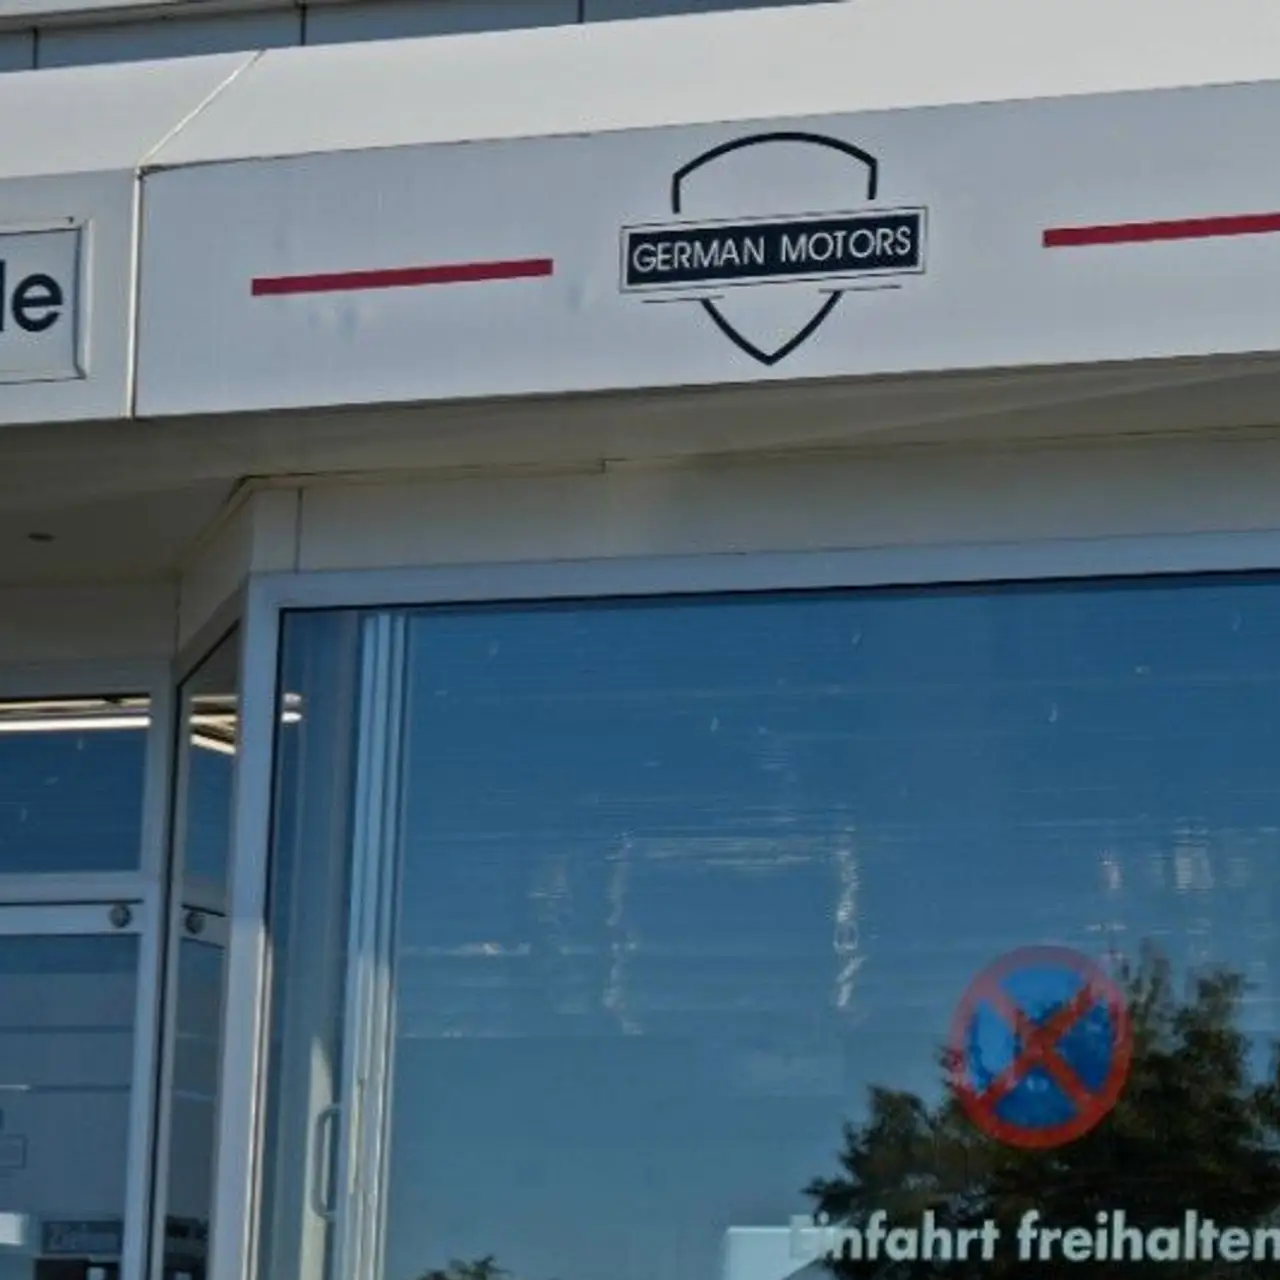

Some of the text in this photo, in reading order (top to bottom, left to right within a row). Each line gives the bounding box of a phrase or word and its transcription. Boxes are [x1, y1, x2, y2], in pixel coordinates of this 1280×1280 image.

[632, 225, 912, 273] GERMAN MOTORS
[789, 1209, 1000, 1262] Einfahrt
